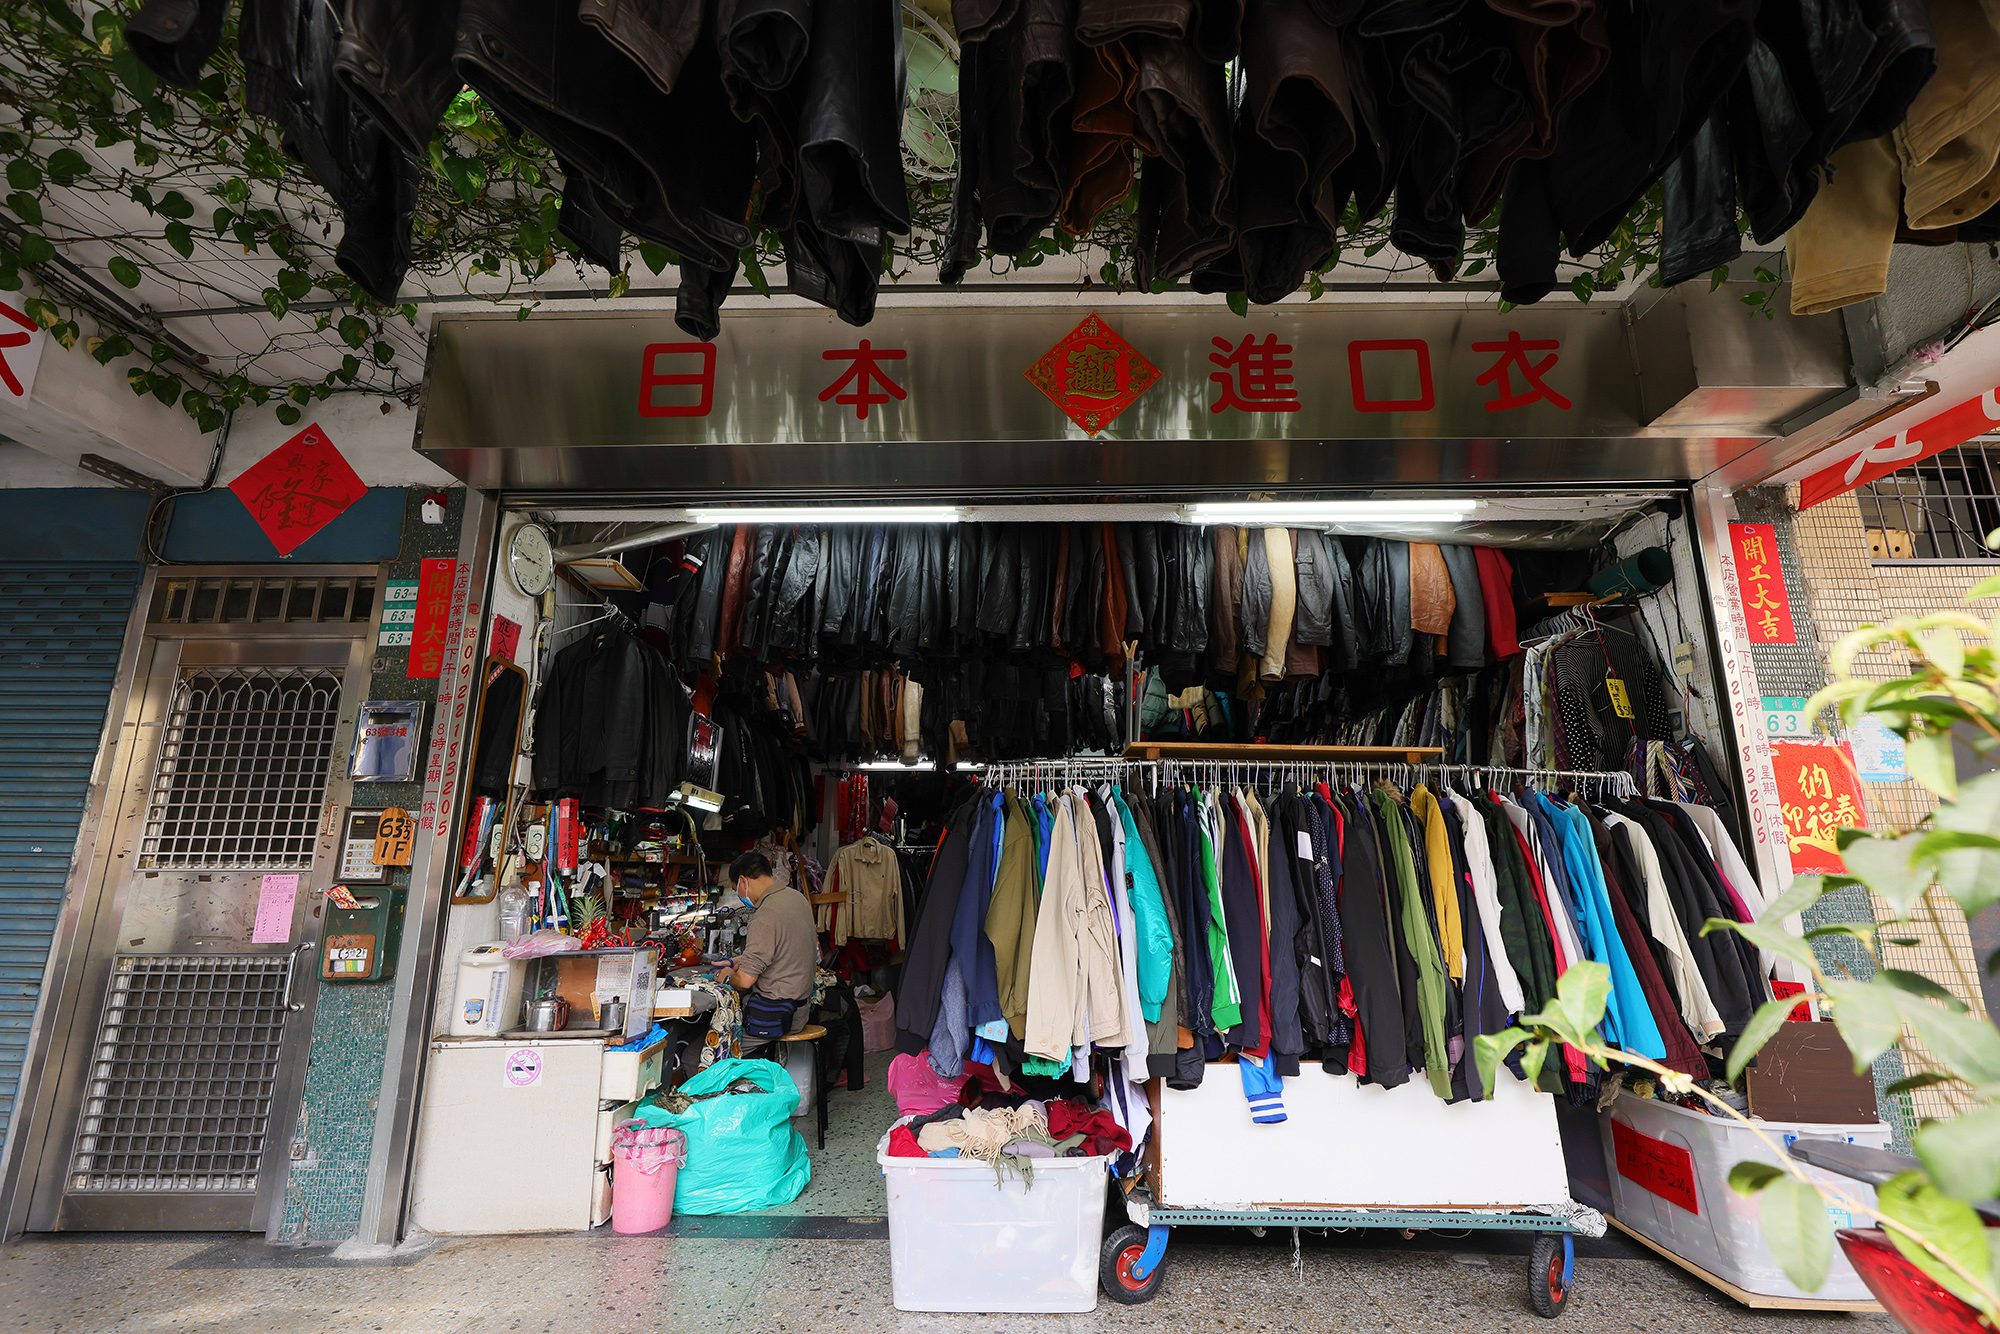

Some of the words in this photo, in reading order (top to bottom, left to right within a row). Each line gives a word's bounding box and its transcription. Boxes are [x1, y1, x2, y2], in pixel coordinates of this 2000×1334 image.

[638, 339, 908, 420] 日本
[1208, 330, 1573, 414] 進口衣
[393, 588, 409, 600] 63
[1740, 535, 1782, 641] 開工大吉
[390, 610, 407, 622] 63
[419, 571, 452, 673] 開市大吉
[387, 632, 404, 644] 63
[1766, 713, 1798, 733] 63
